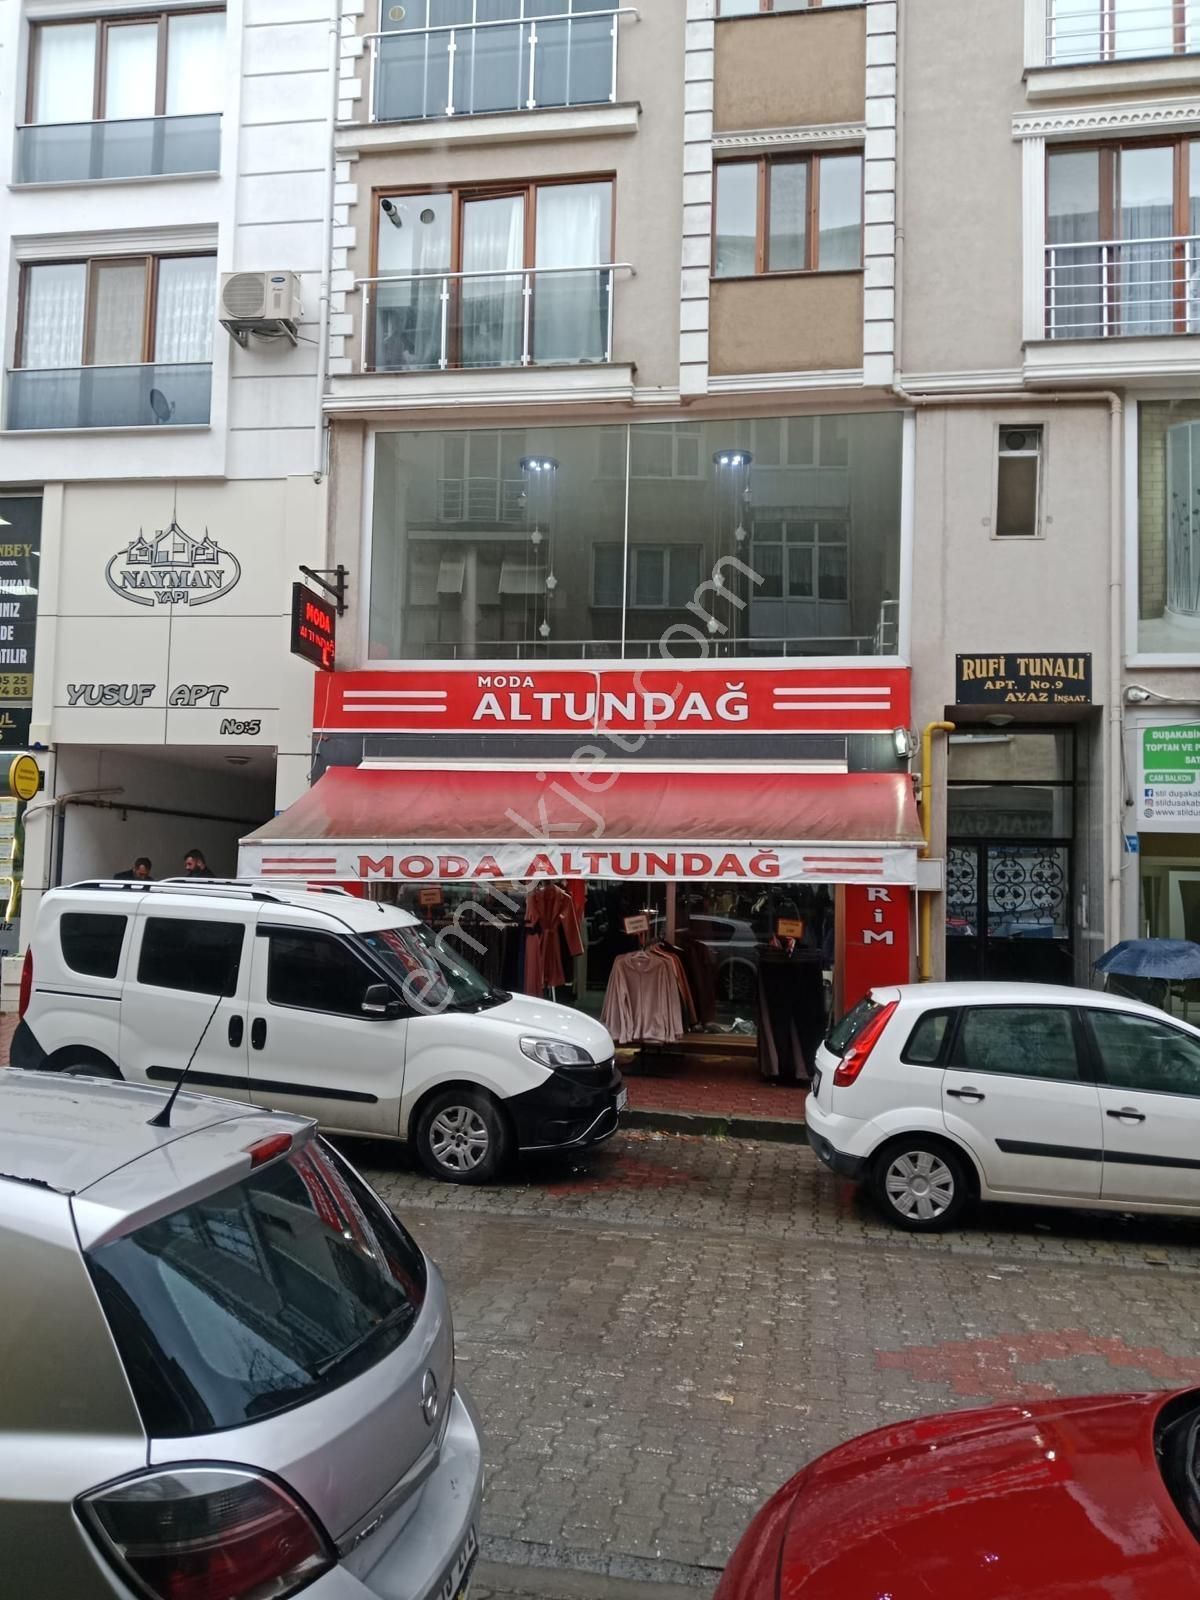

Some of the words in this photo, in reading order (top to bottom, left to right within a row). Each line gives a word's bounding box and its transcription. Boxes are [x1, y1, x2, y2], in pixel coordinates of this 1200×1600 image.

[120, 570, 225, 589] NAYMAN
[154, 590, 189, 604] YAPI
[306, 602, 331, 633] MODA
[0, 648, 28, 664] TILIR
[962, 656, 1006, 681] RUFİ
[1017, 657, 1085, 680] TUNALI
[13, 675, 28, 685] 25
[478, 676, 535, 688] MODA
[13, 686, 28, 695] 83
[67, 684, 156, 706] YUSUF
[169, 684, 229, 706] APT
[1004, 692, 1049, 702] AYAZ
[472, 682, 749, 722] ALTUNDAĞ
[219, 718, 261, 736] No:5
[1144, 743, 1181, 752] TOPTAN
[1181, 743, 1193, 752] VE
[358, 855, 505, 879] MODA
[524, 849, 781, 877] ALTUNDAĞ
